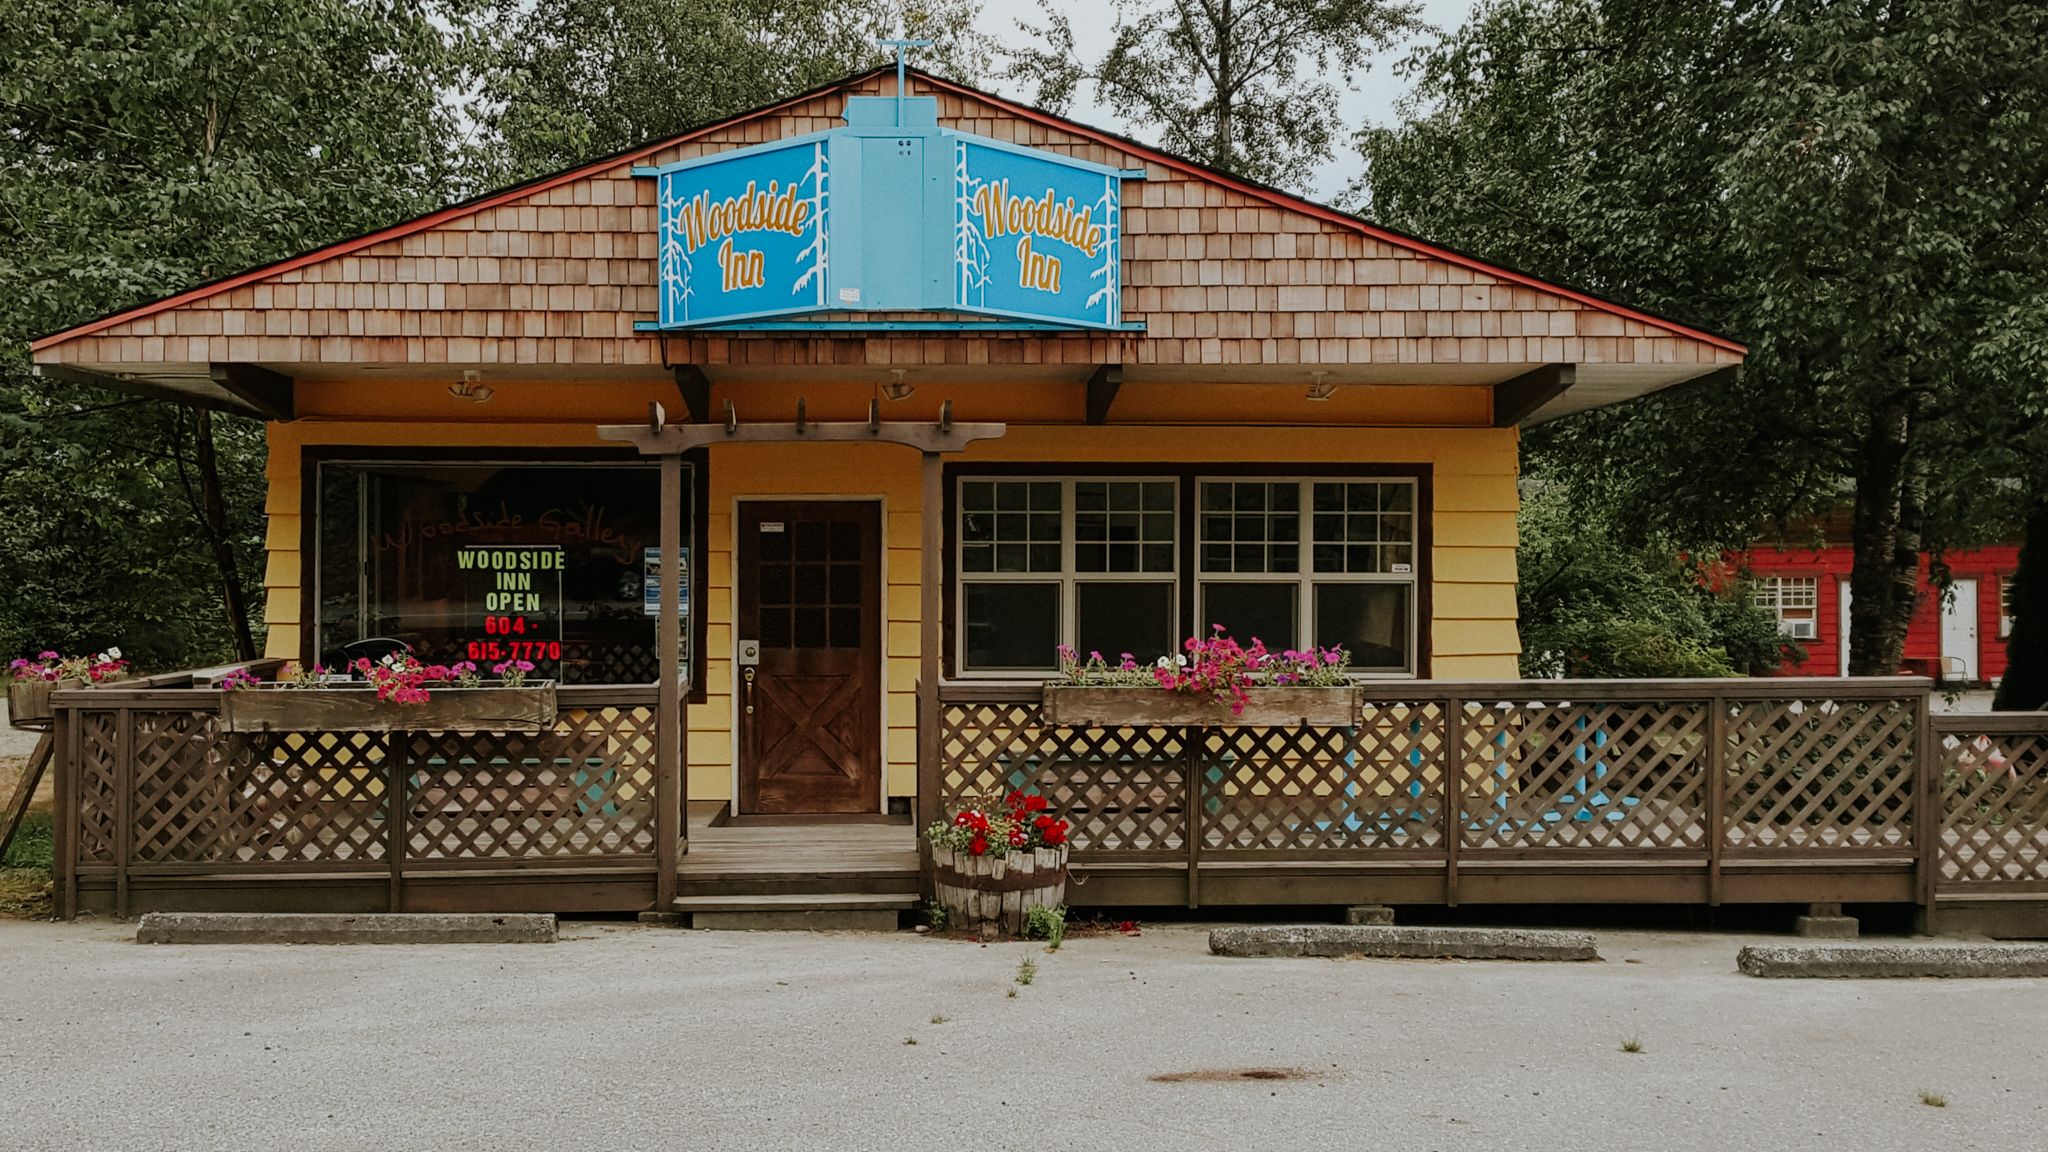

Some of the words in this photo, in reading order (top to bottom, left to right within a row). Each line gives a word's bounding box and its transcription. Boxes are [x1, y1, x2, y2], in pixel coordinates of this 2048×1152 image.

[678, 180, 809, 254] Woodside
[974, 178, 1101, 259] Woodside
[718, 237, 765, 292] Inn
[1017, 235, 1061, 294] Inn
[370, 494, 523, 551] Woodside
[539, 501, 642, 566] Gallery
[457, 550, 565, 570] WOODSIDE
[496, 572, 531, 591] INN
[486, 592, 540, 611] OPEN
